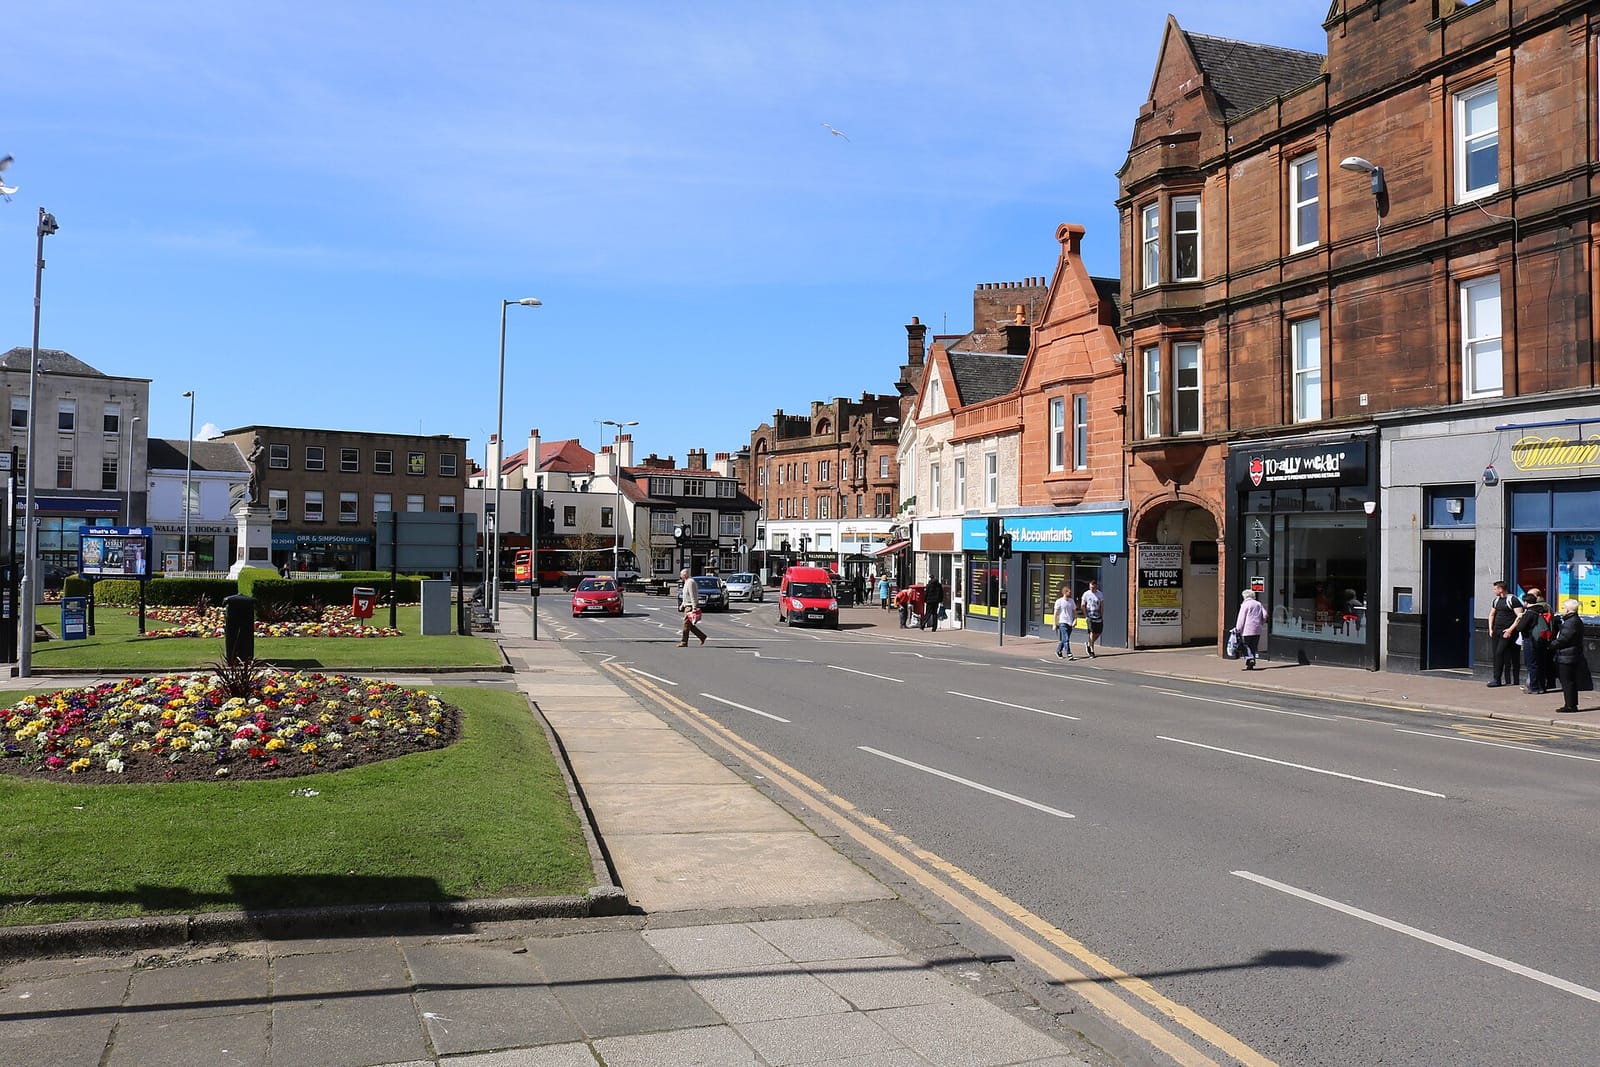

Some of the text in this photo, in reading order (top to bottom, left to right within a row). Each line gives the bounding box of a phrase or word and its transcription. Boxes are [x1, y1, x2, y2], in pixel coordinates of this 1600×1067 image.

[1021, 527, 1073, 542] Accountants
[318, 535, 346, 543] SIMPSON
[1159, 570, 1178, 578] NOOK
[1148, 579, 1168, 587] CAFE
